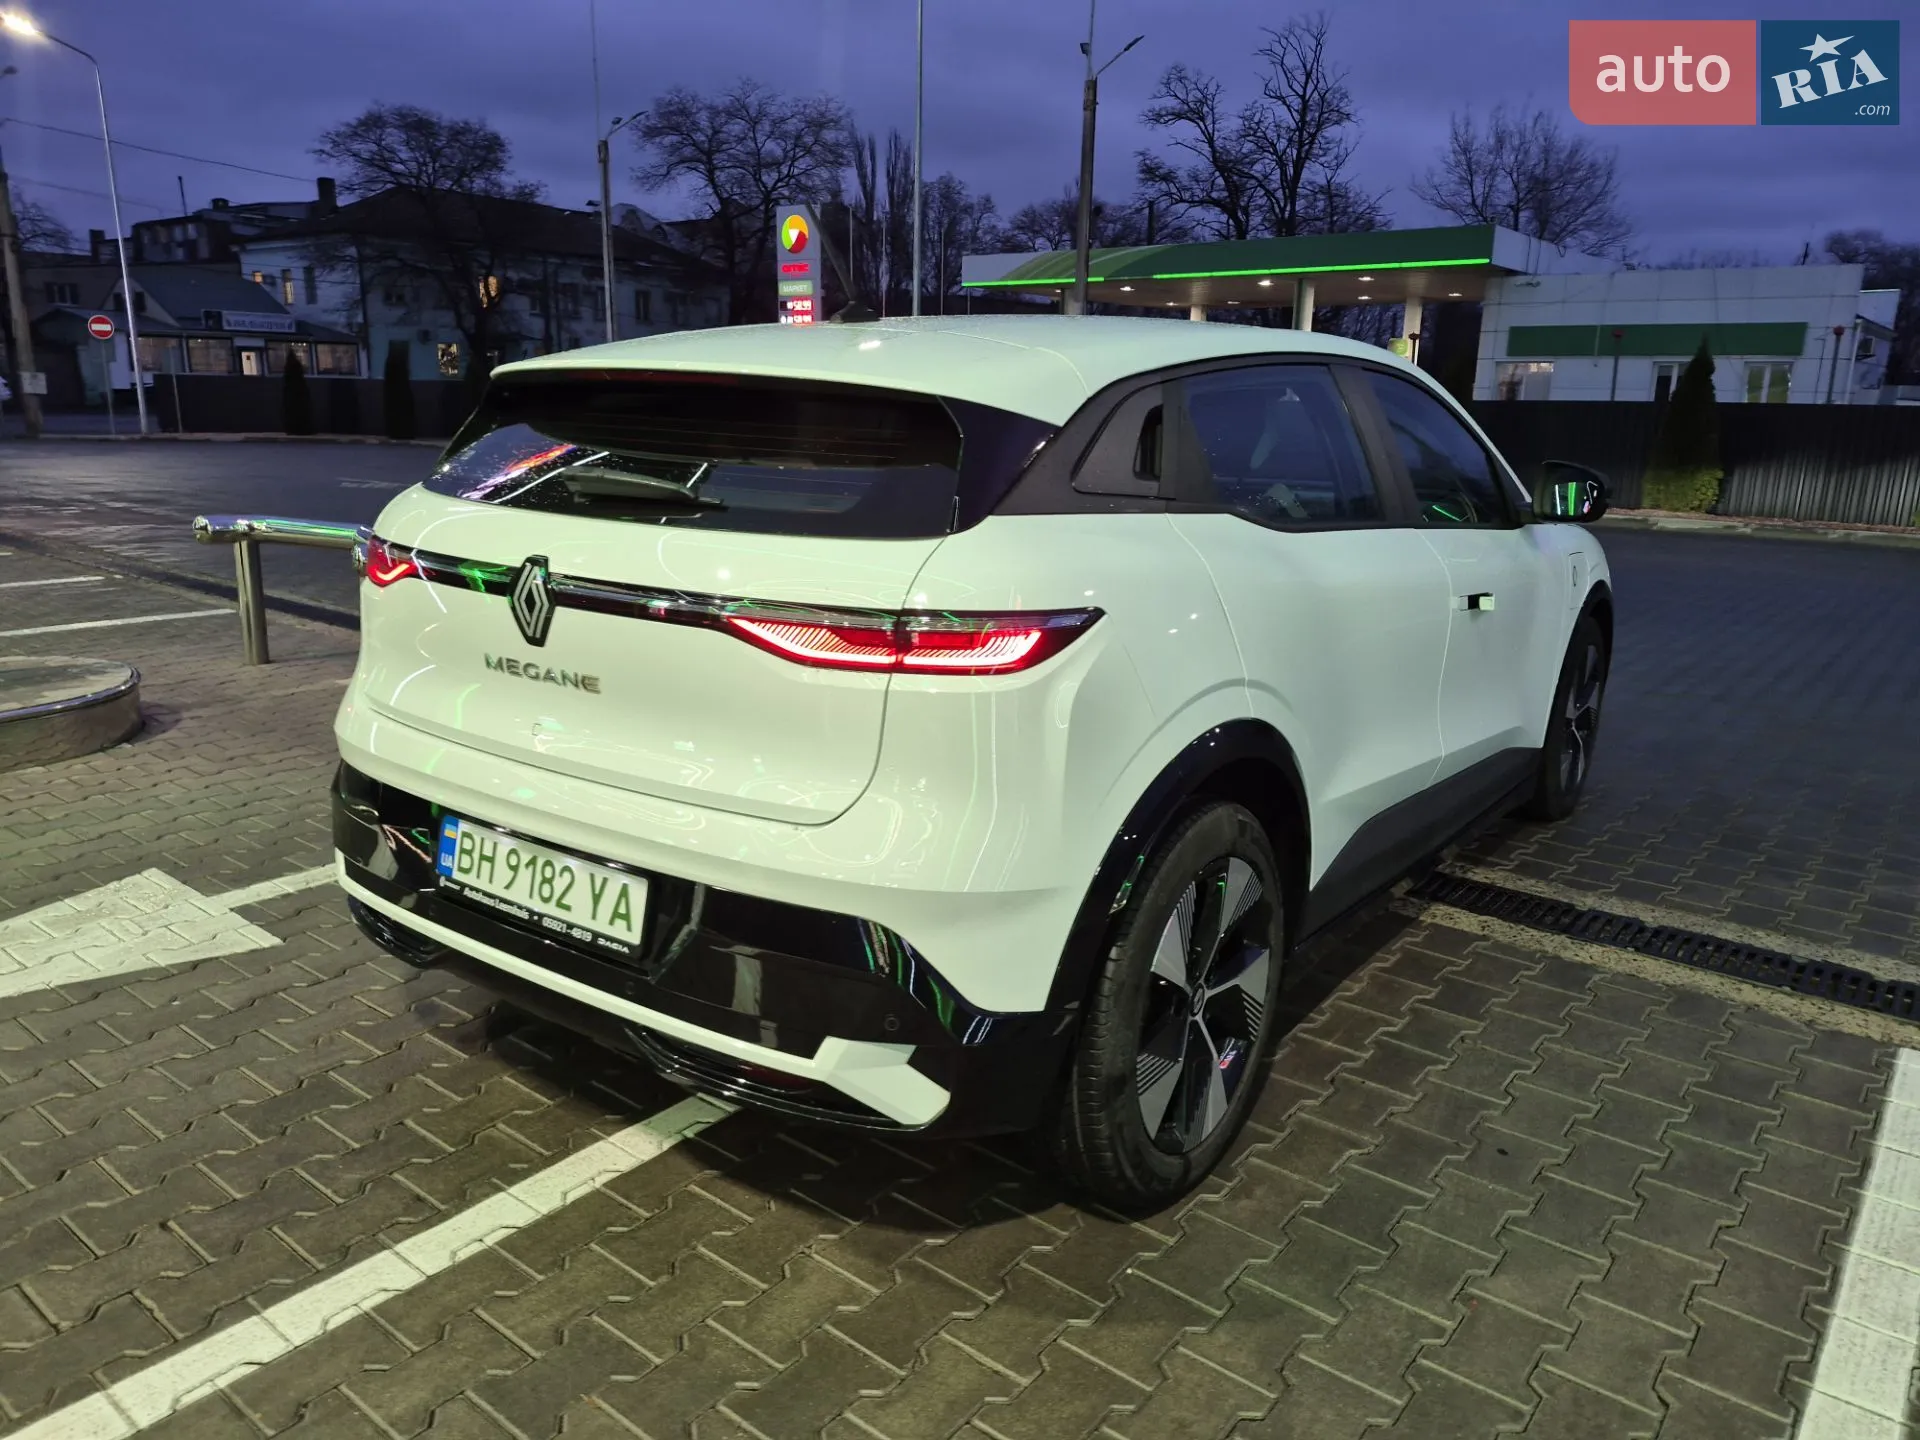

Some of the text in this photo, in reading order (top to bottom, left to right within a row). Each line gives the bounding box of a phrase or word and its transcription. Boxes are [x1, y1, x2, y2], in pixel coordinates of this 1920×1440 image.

[484, 653, 601, 694] MEGANE
[441, 853, 454, 869] UA
[457, 830, 633, 933] BH 9182 YA
